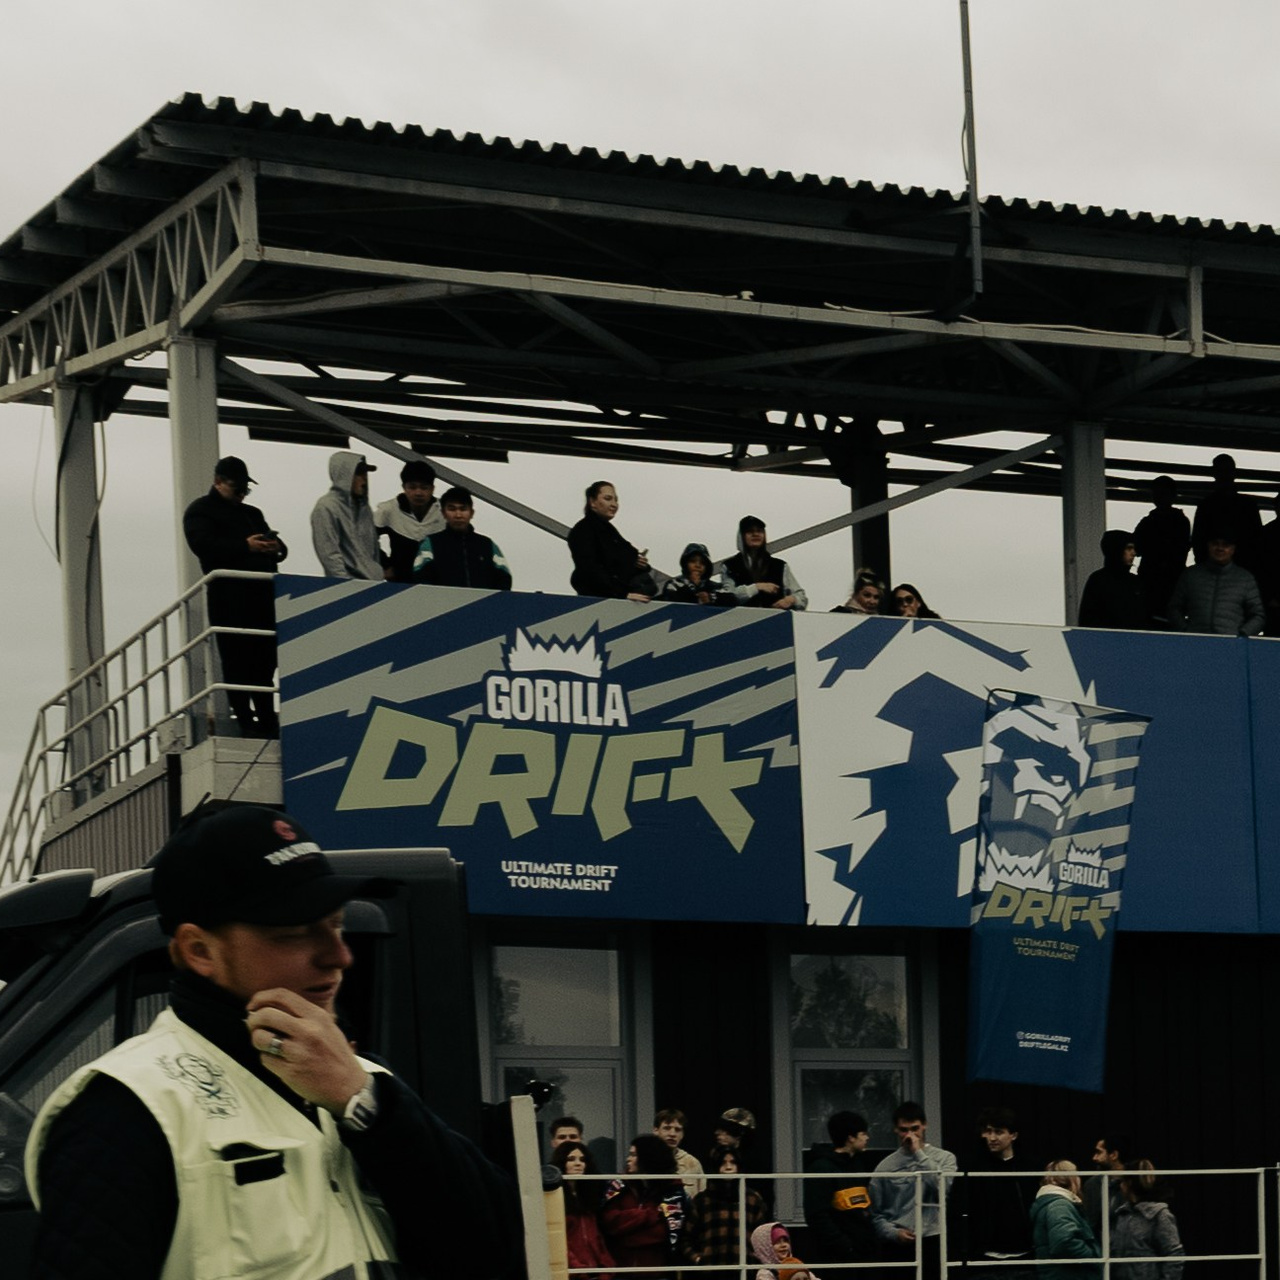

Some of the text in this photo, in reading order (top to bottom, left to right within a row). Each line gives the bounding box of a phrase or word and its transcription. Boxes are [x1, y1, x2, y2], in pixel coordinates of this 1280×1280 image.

[486, 676, 628, 727] GORILLA
[335, 705, 765, 854] DRIFT
[501, 860, 618, 877] ULTIMATE DRIFT
[1059, 862, 1109, 888] GORILLA
[507, 875, 612, 891] TOURNAMENT
[982, 881, 1112, 940] DRIFT
[1013, 937, 1058, 949] ULTIMATE
[1018, 947, 1076, 961] TOURNAMENT
